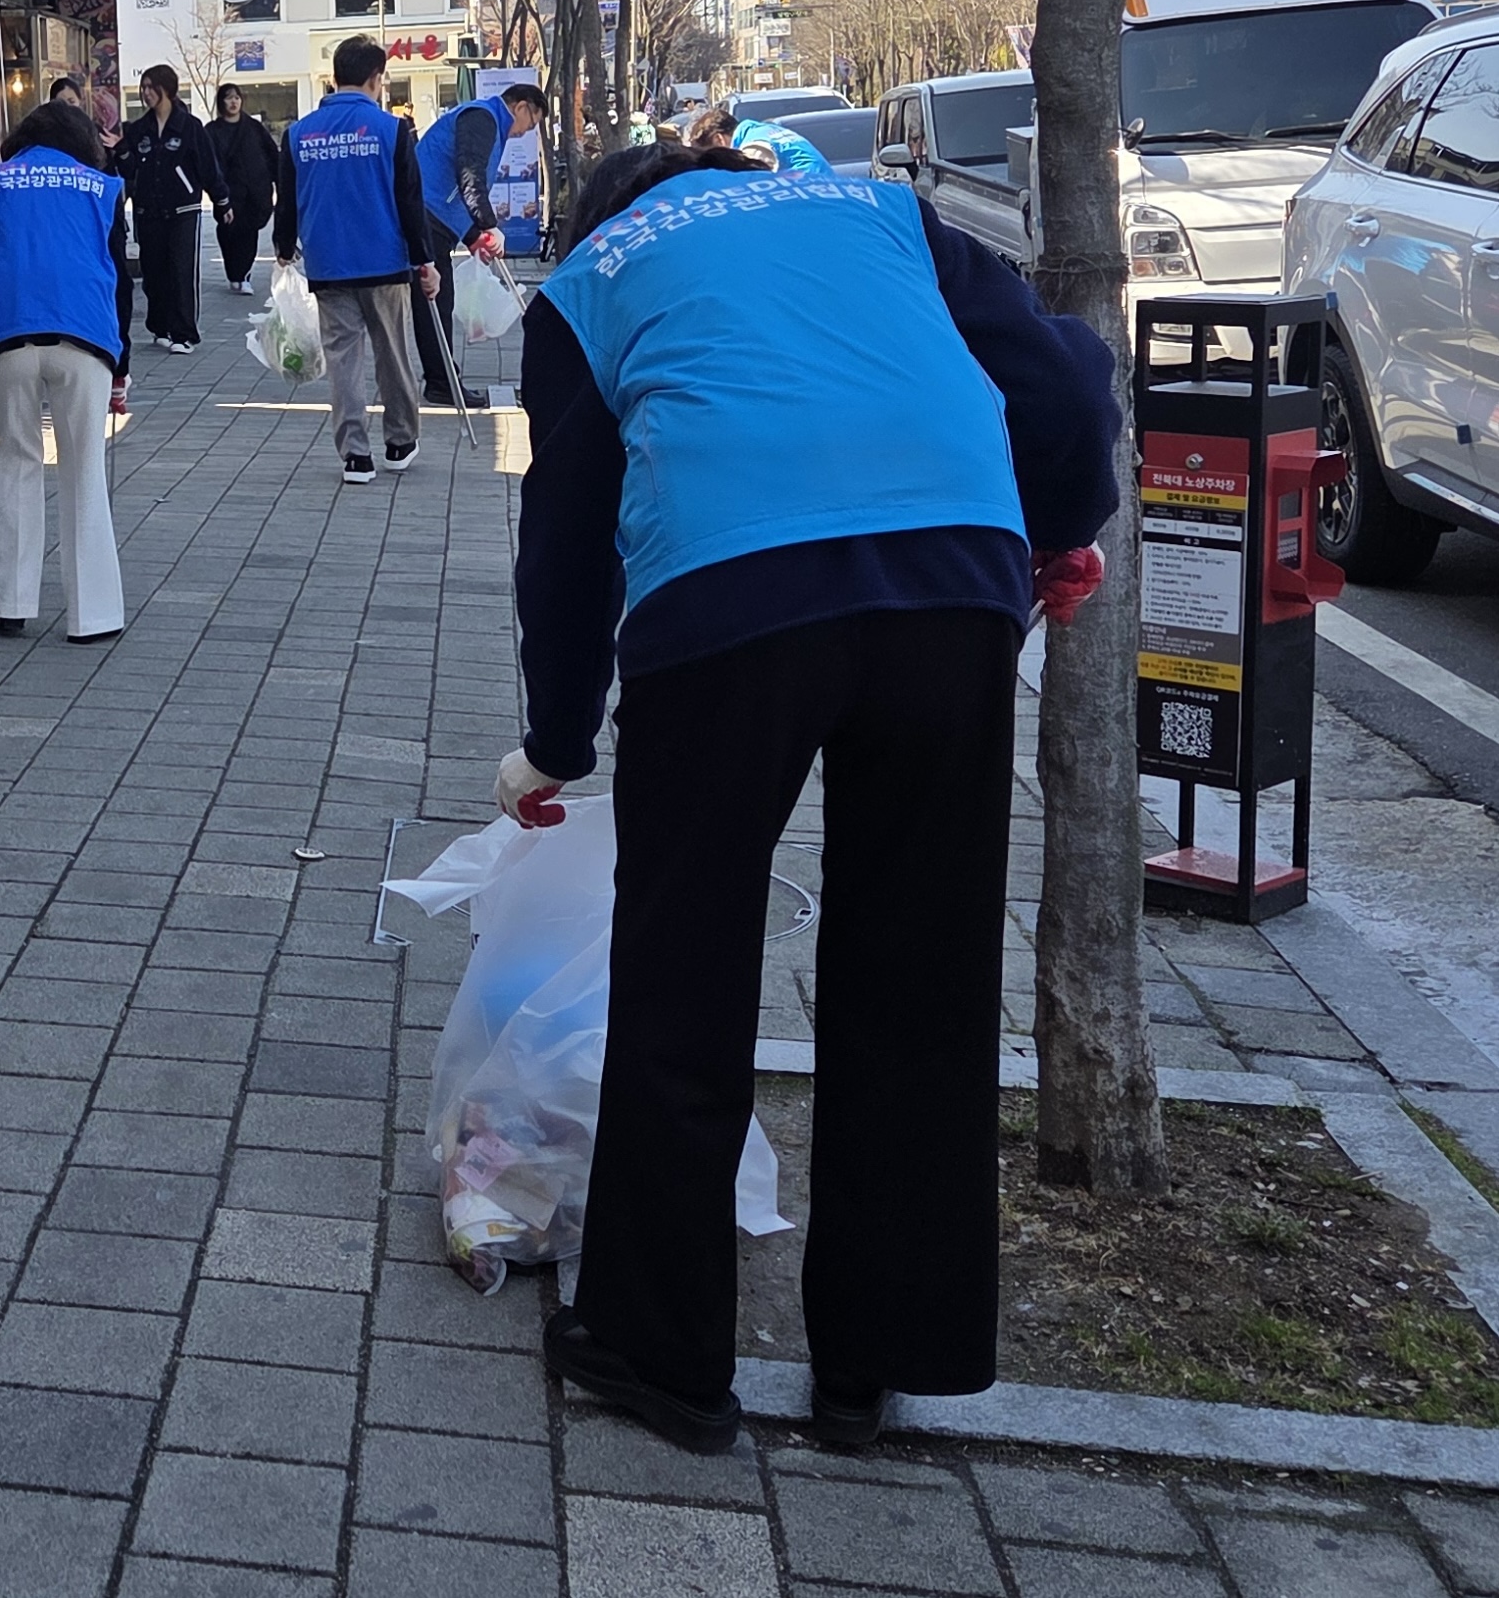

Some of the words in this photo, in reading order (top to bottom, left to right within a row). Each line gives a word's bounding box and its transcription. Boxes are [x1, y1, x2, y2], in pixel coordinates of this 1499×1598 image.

[298, 143, 380, 163] 한국건강관리협회
[593, 185, 880, 279] 한국건강관리협회
[1152, 473, 1183, 487] 전북대
[1184, 476, 1236, 492] 노상주차장
